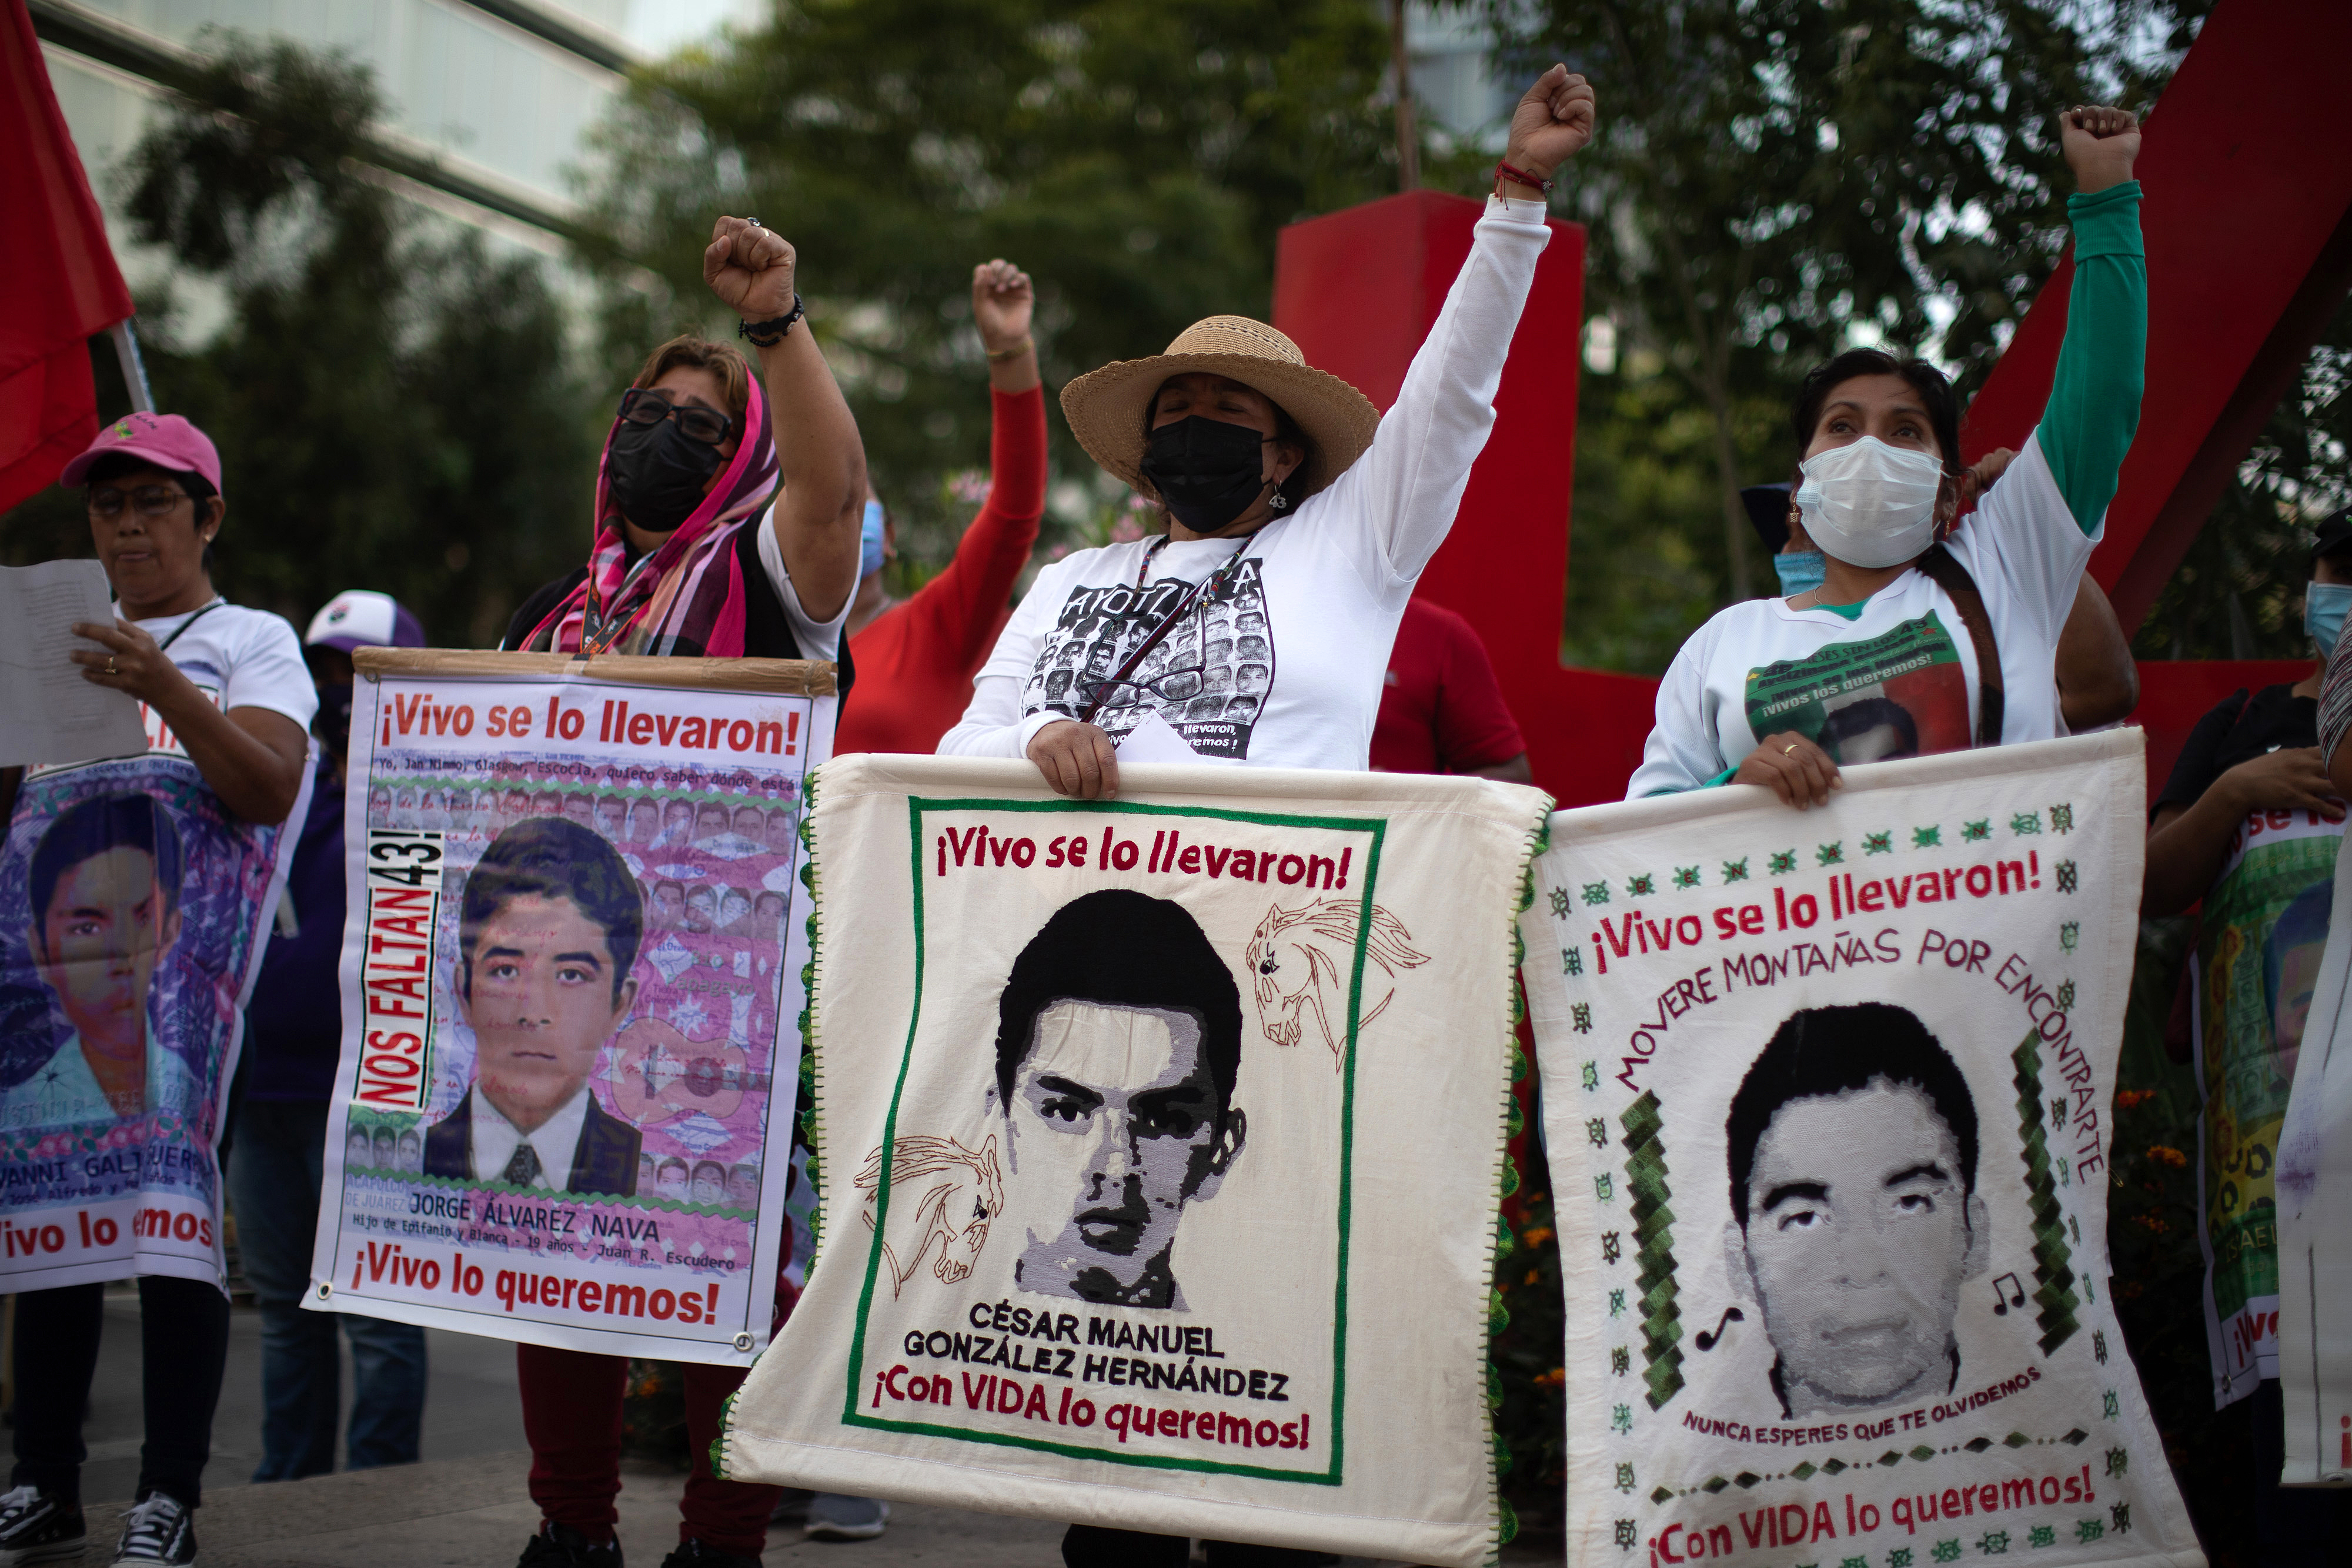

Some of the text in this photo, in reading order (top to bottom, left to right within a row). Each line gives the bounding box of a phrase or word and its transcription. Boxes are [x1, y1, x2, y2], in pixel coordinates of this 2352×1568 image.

[1269, 495, 1287, 509] 43
[1843, 644, 1870, 658] SIN
[1874, 633, 1897, 646] LOS
[1900, 620, 1927, 636] 43
[1813, 684, 1839, 700] los
[1843, 653, 1933, 690] queremos!
[382, 693, 800, 755] ¡Vivo se lo llevaron!
[1184, 724, 1236, 735] llevaron,
[380, 758, 397, 771] Yo,
[405, 758, 424, 770] Jan
[475, 759, 527, 774] Glasgow,
[537, 761, 596, 778] Escocia,
[606, 768, 654, 781] quiero
[663, 771, 703, 784] saber
[710, 773, 753, 788] dónde
[760, 777, 794, 791] está
[937, 825, 1352, 890] ¡Vivo se lo llevaron!
[1591, 850, 2041, 974] ¡Vivo se lo llevaron!
[359, 830, 442, 1107] NOS FALTAN 43!
[666, 972, 755, 999] Papagayo
[1615, 928, 2104, 1184] MOVERE MONTAÑAS POR ENCONTRARTE
[345, 1192, 359, 1206] DE
[410, 1193, 660, 1243] JORGE ÁLVAREZ NAVA
[78, 1211, 118, 1249] lo
[353, 1213, 378, 1230] Hijo
[384, 1218, 397, 1230] de
[402, 1220, 452, 1237] Epifanio
[457, 1228, 465, 1241] y
[470, 1228, 509, 1245] Blanca
[528, 1236, 540, 1248] 19
[547, 1238, 574, 1253] años
[597, 1244, 631, 1260] Juan
[640, 1249, 656, 1262] R.
[666, 1252, 736, 1271] Escudero
[351, 1241, 720, 1326] ¡Vivo lo queremos!
[970, 1298, 1225, 1359] CÉSAR MANUEL
[904, 1335, 1289, 1402] GONZÁLEZ HERNÁNDEZ
[871, 1364, 1309, 1450] ¡Con VIDA lo queremos!
[1682, 1366, 2042, 1446] NUNCA ESPERES QUE TE OLVIDEMOS
[1648, 1464, 2096, 1568] ¡Con VIDA lo queremos!
